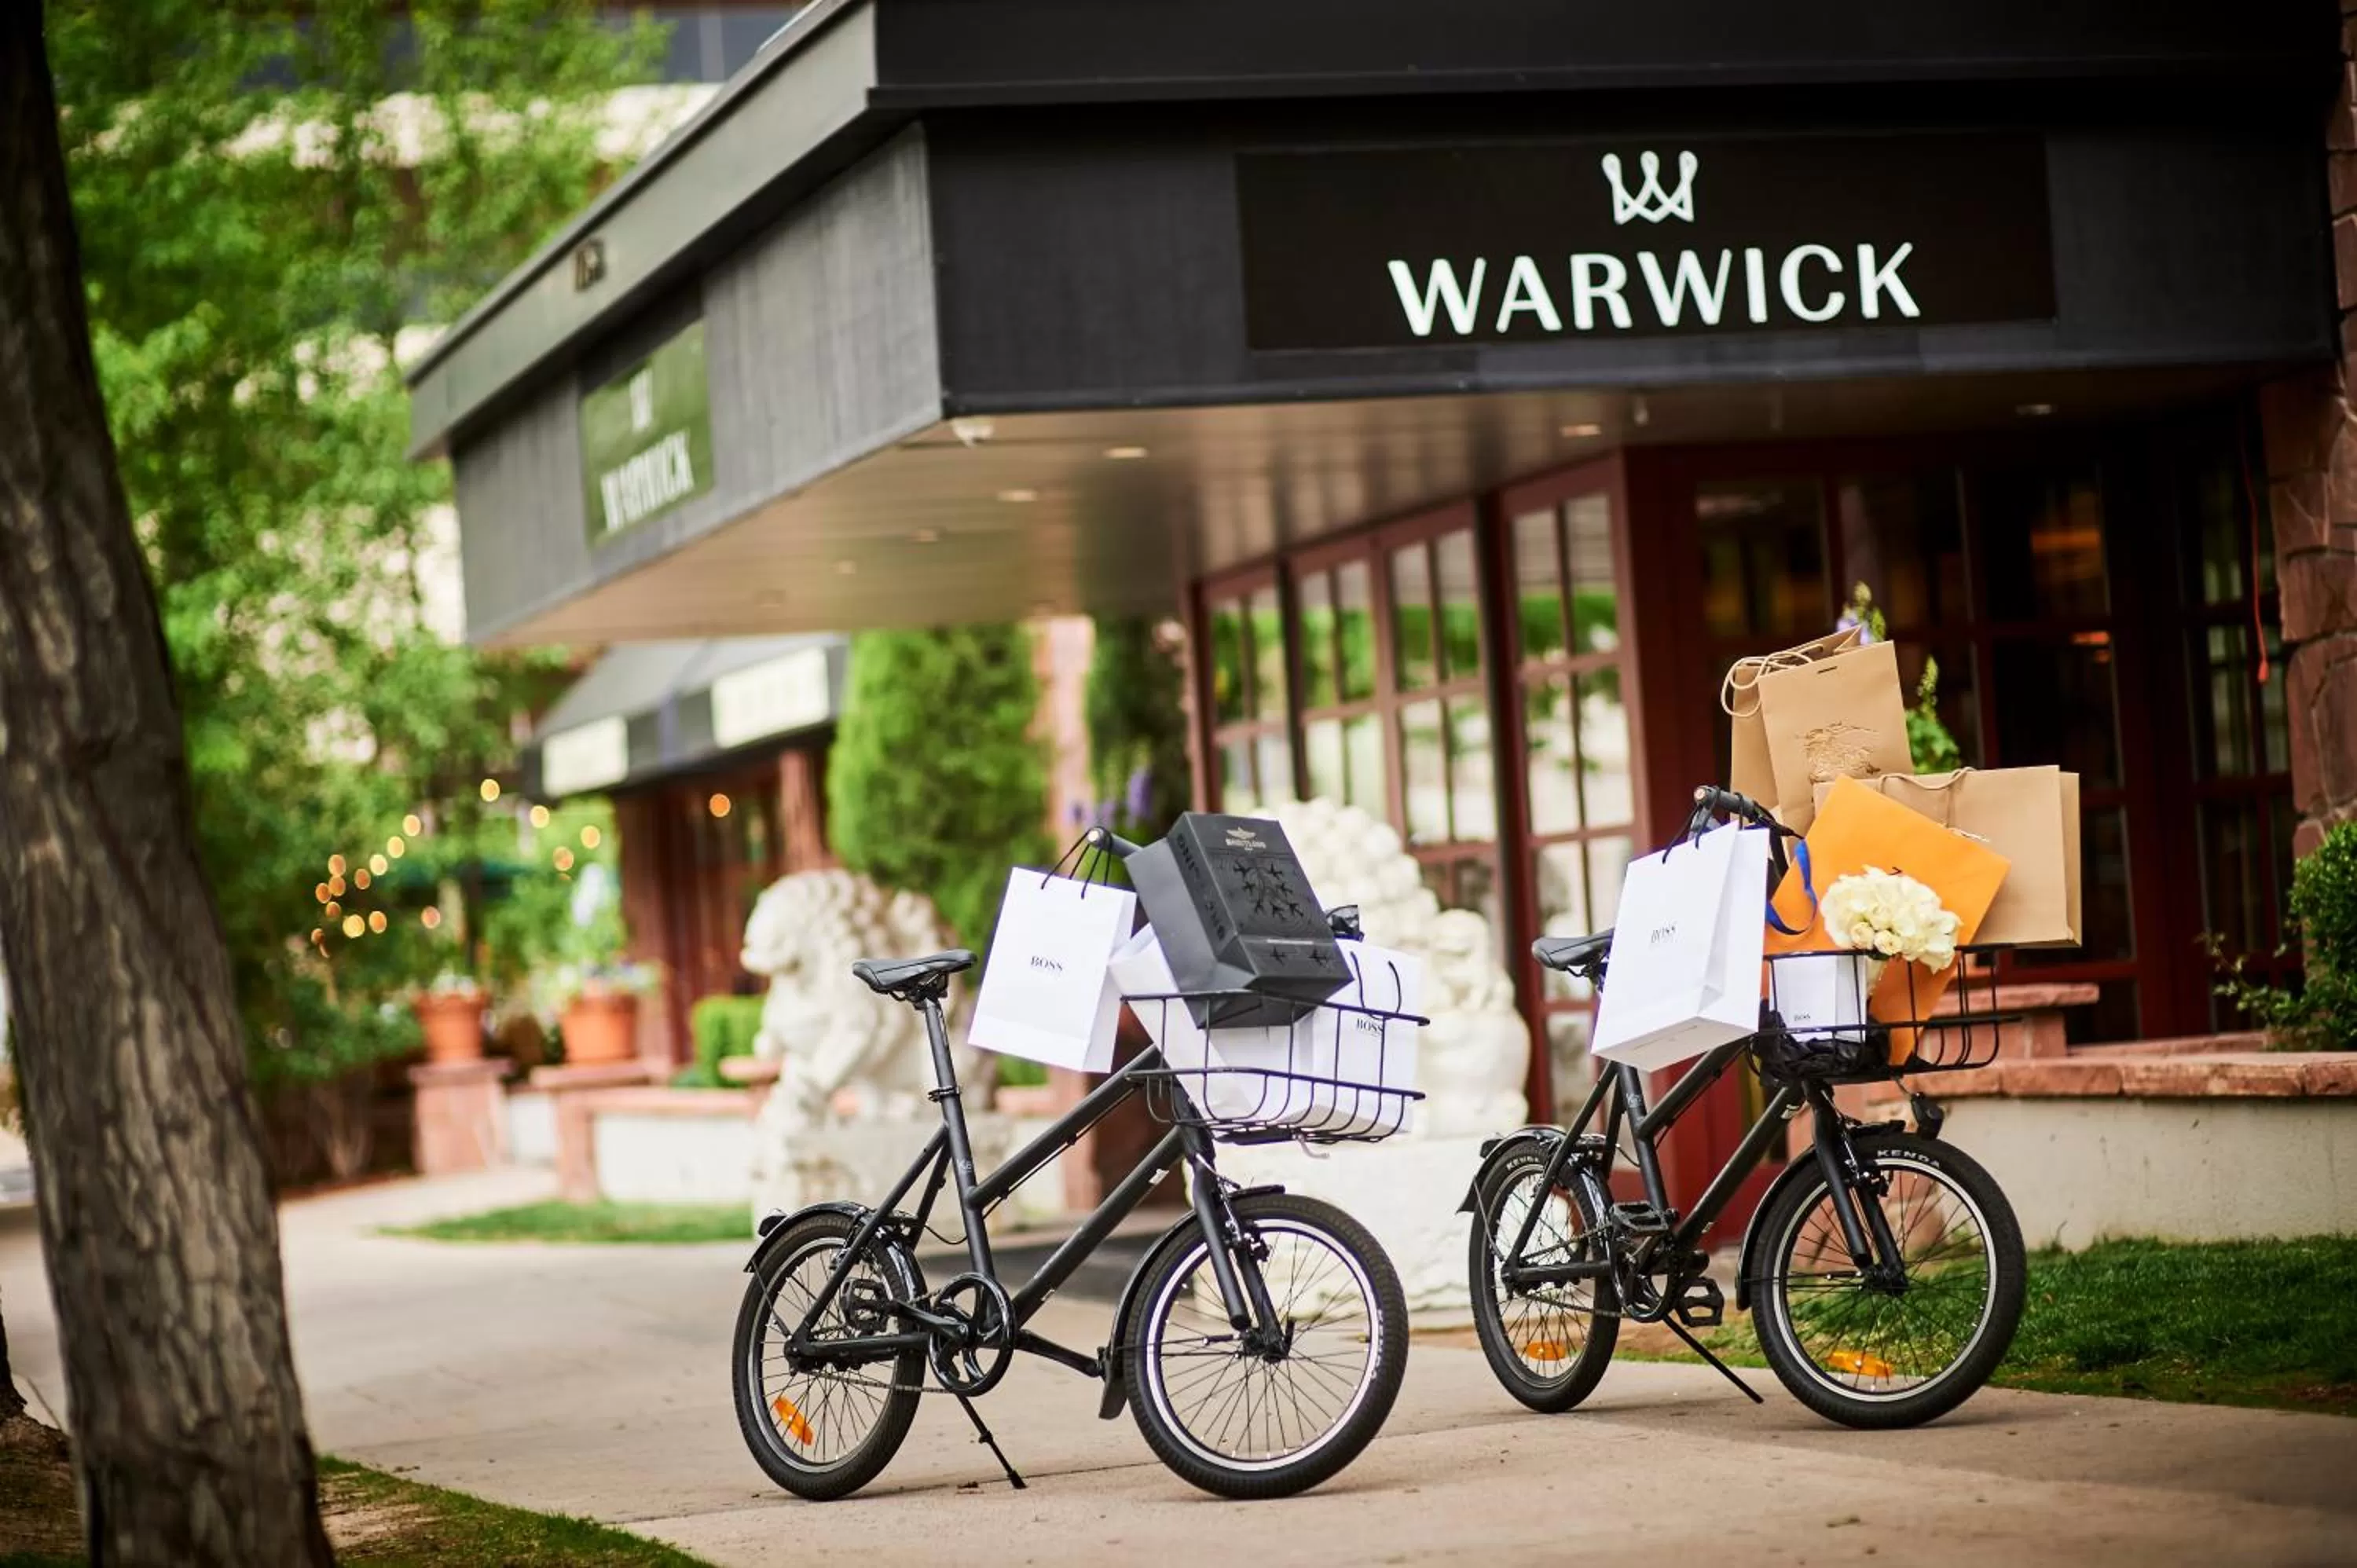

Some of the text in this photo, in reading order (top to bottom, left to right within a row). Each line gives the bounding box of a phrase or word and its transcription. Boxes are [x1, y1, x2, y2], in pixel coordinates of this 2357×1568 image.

[1387, 242, 1921, 336] WARWICK
[1030, 955, 1064, 972] BOSS
[1877, 1149, 1940, 1169] KENDA
